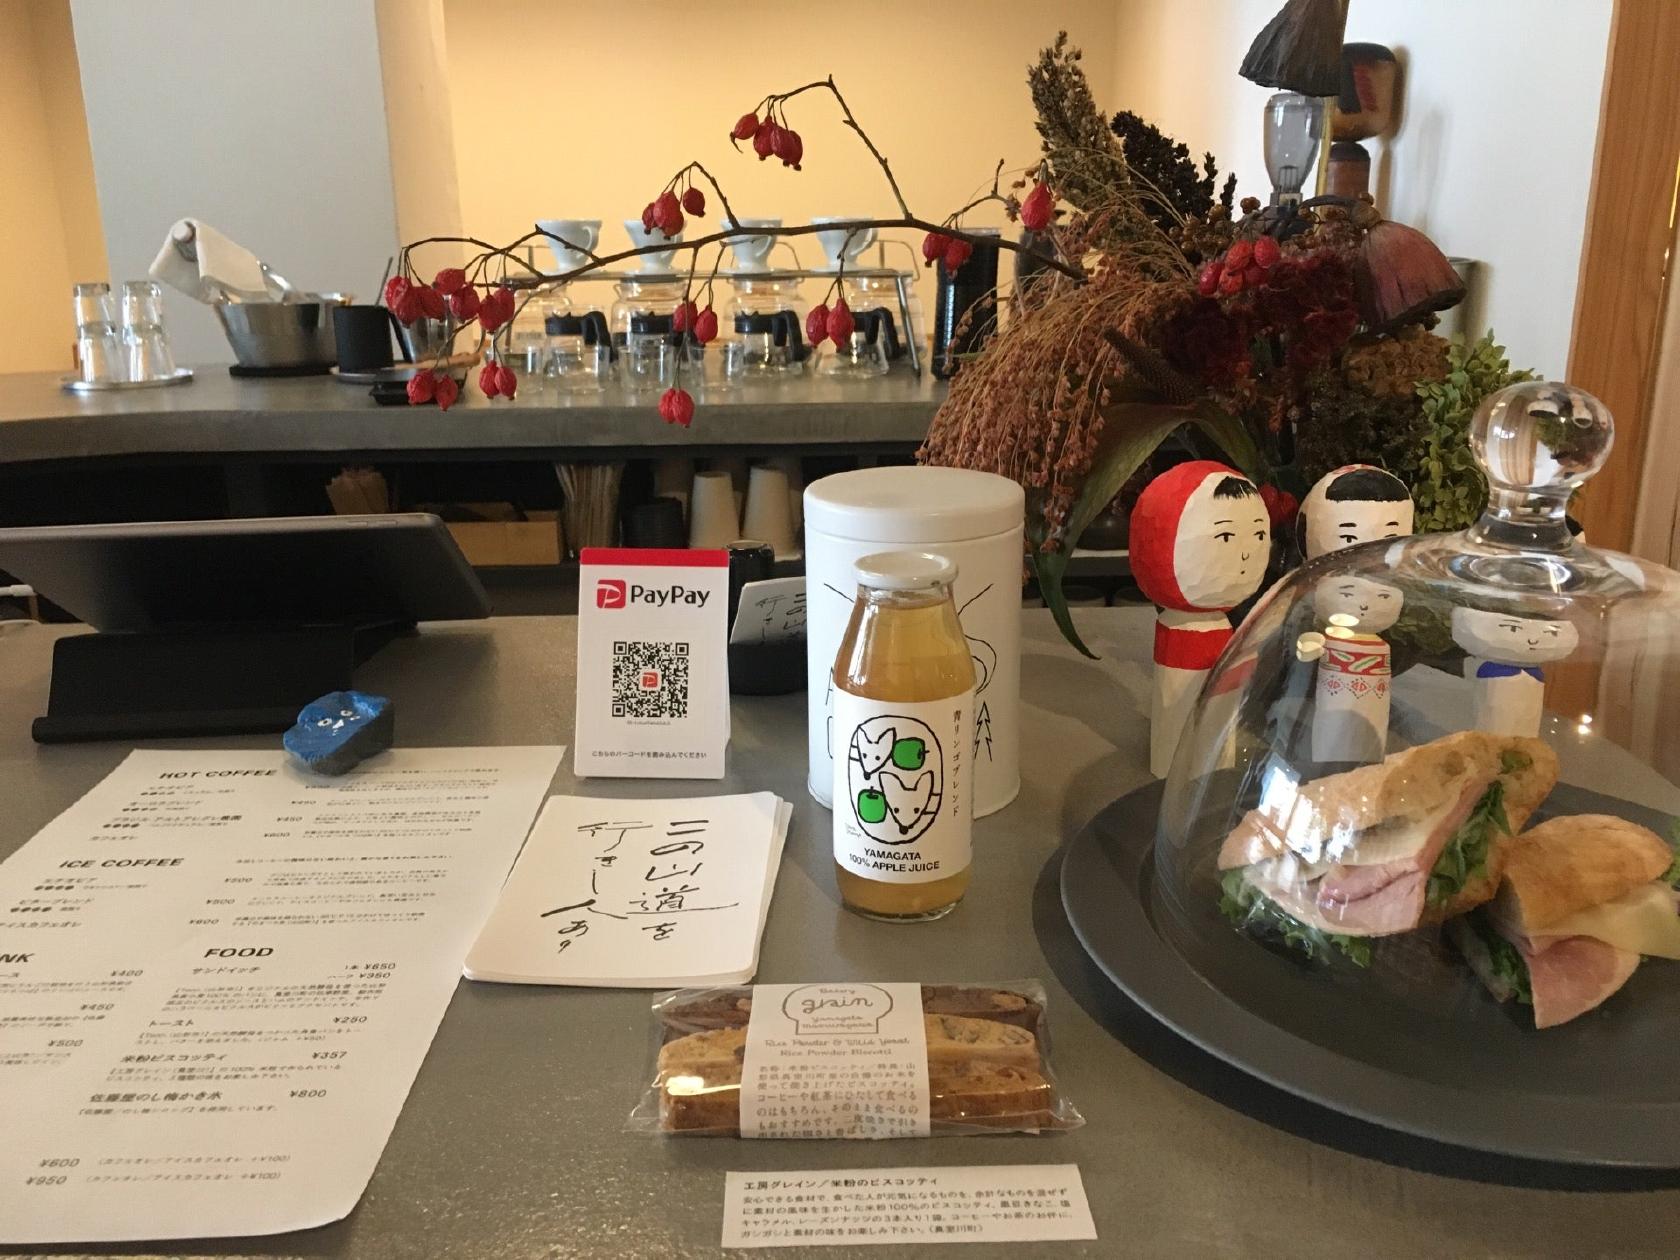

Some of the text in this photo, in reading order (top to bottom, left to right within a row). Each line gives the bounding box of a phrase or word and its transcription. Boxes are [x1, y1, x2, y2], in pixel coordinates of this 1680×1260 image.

[630, 585, 711, 608] PayPay
[591, 750, 708, 759] こちらのバーコードを読み込んでください
[159, 768, 279, 780] HOT COFFEE
[864, 847, 921, 861] YAMAGATA
[58, 857, 185, 869] ICE COFFEE
[848, 853, 940, 873] 100% APPLE JUICE
[203, 947, 275, 959] FOOD
[191, 966, 262, 975] サンドイッチ
[363, 962, 397, 971] ¥650
[110, 969, 144, 978] ¥400
[80, 1003, 115, 1011] ¥450
[801, 995, 875, 1014] grain
[149, 1018, 195, 1028] トースト
[331, 1015, 368, 1024] ¥250
[47, 1039, 84, 1048] ¥500
[765, 1039, 788, 1047] Rice
[793, 1038, 830, 1047] Powder
[311, 1050, 348, 1060] ¥357
[780, 1048, 893, 1057] Rice Powder Biscotti
[120, 1053, 228, 1064] 米粉ビスコッティ
[289, 1089, 328, 1099] ¥800
[39, 1157, 81, 1168] ¥600
